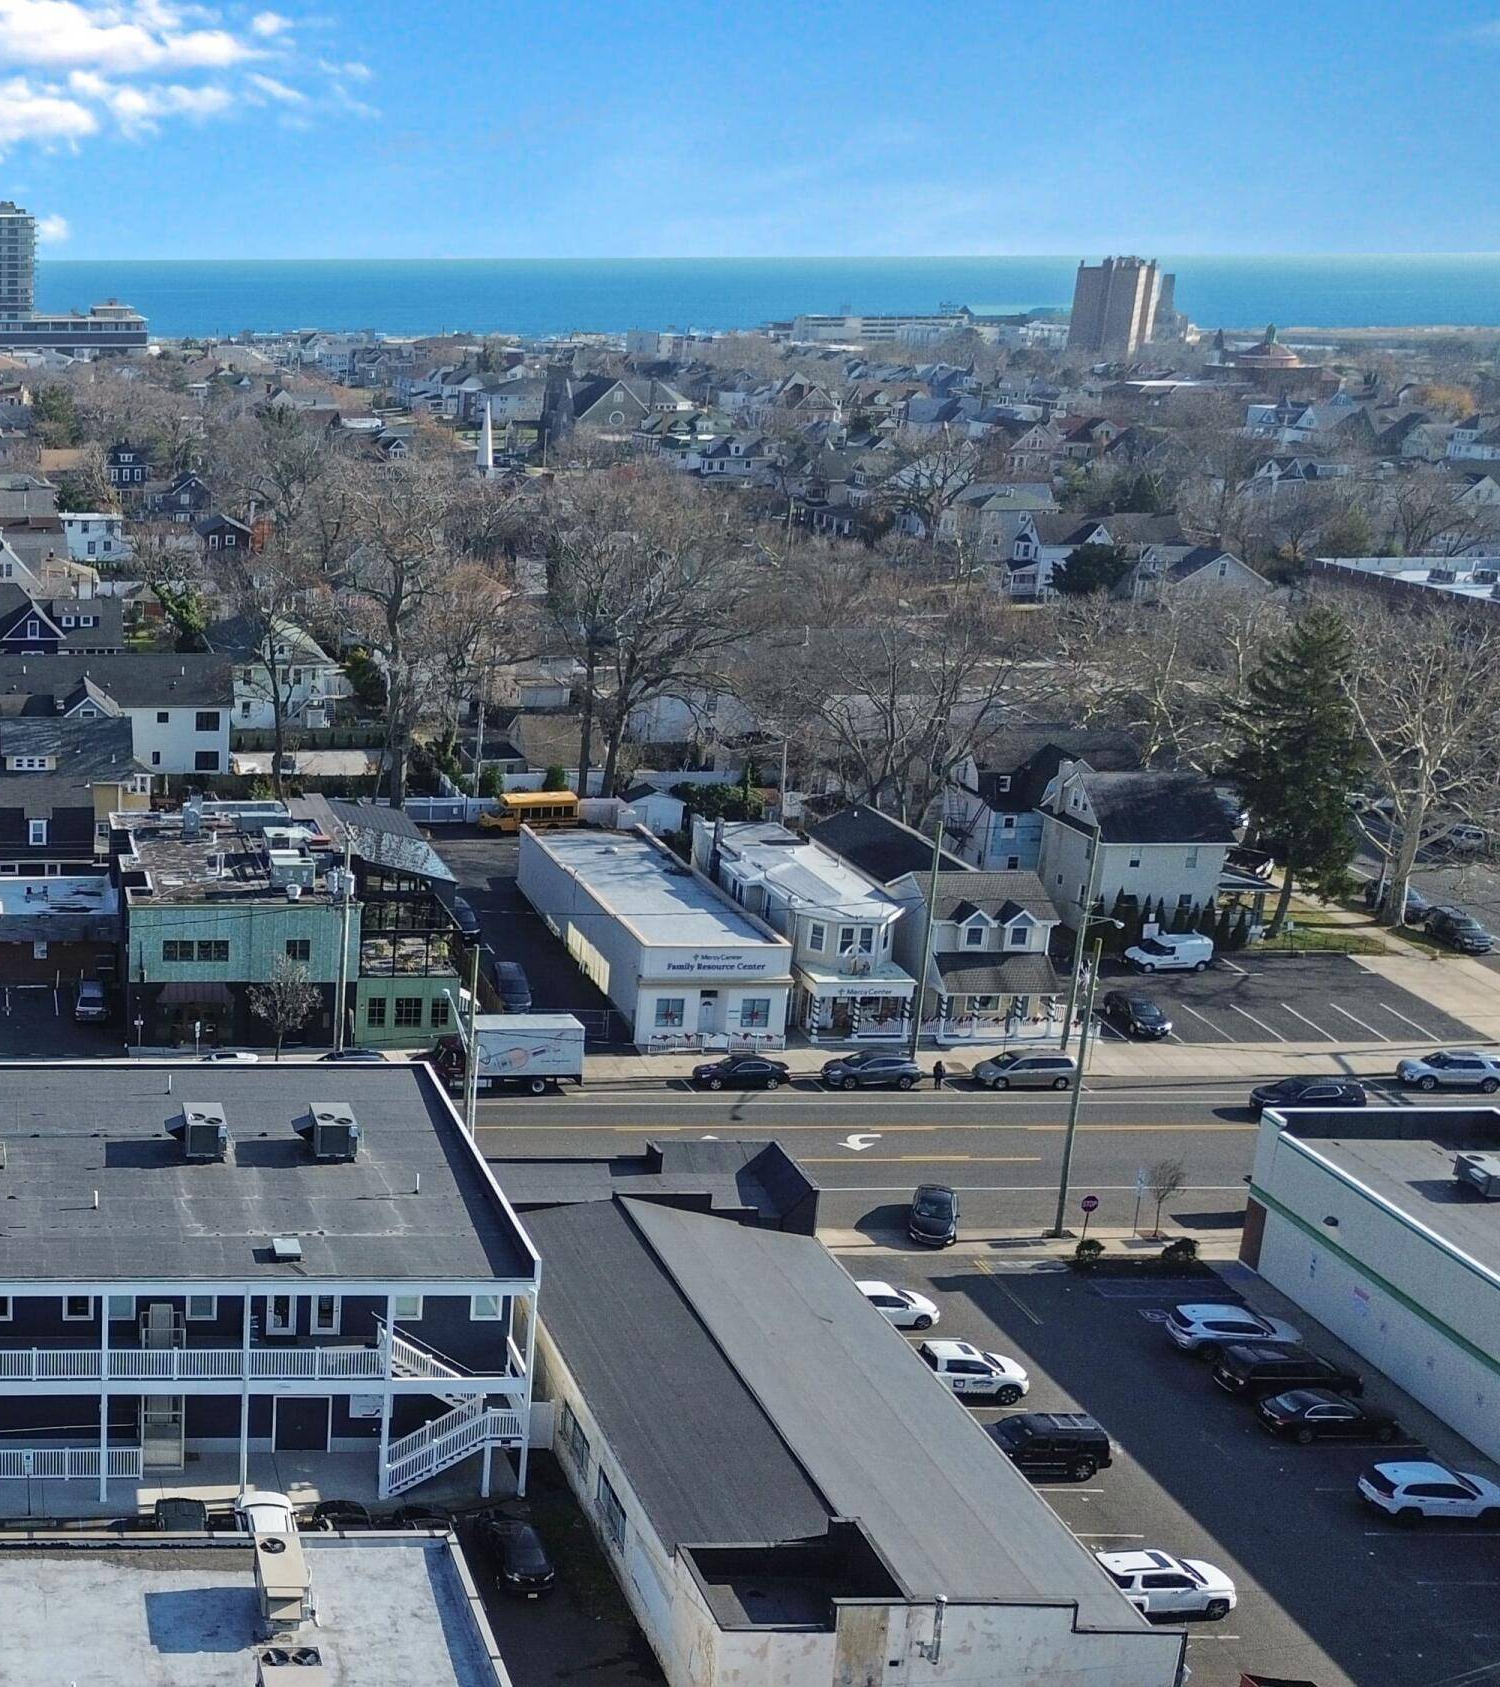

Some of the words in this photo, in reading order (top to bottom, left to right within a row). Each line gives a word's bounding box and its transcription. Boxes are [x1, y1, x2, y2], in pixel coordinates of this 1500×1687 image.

[667, 962, 695, 972] Family
[696, 962, 736, 971] Resource
[737, 962, 766, 971] Center
[846, 988, 868, 996] Mercy
[1082, 1200, 1098, 1208] STOP
